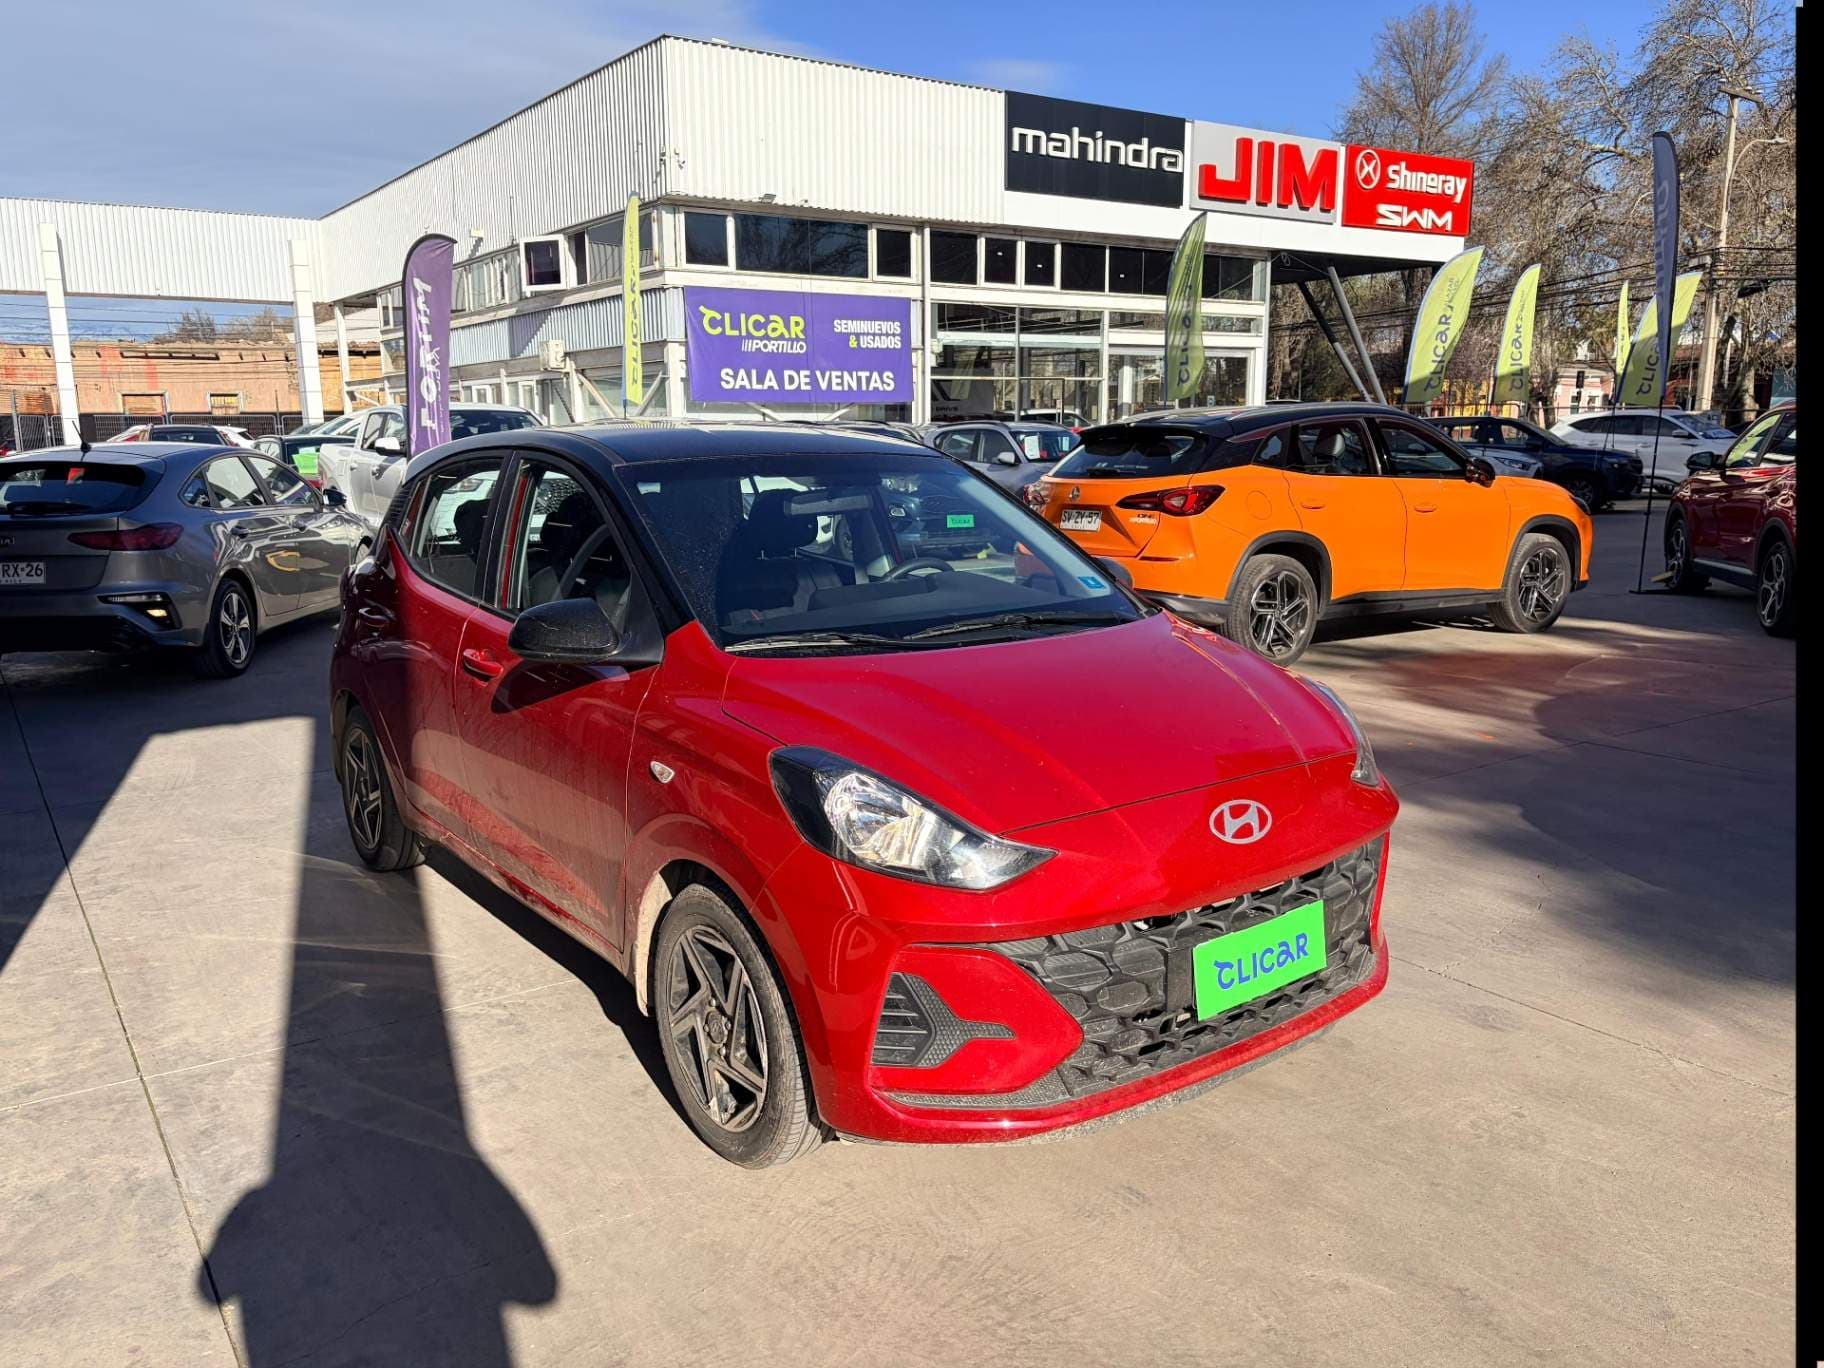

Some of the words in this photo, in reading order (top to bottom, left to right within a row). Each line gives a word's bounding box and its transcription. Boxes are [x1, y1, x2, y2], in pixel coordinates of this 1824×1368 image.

[1012, 127, 1183, 172] mahindra
[1198, 137, 1338, 213] JIM
[1376, 204, 1453, 231] SWM
[833, 319, 901, 333] SEMINUEVOS
[849, 335, 858, 348] &
[860, 336, 901, 348] USADOS
[720, 368, 779, 389] SALA
[784, 370, 812, 390] DE
[815, 370, 895, 391] VENTAS
